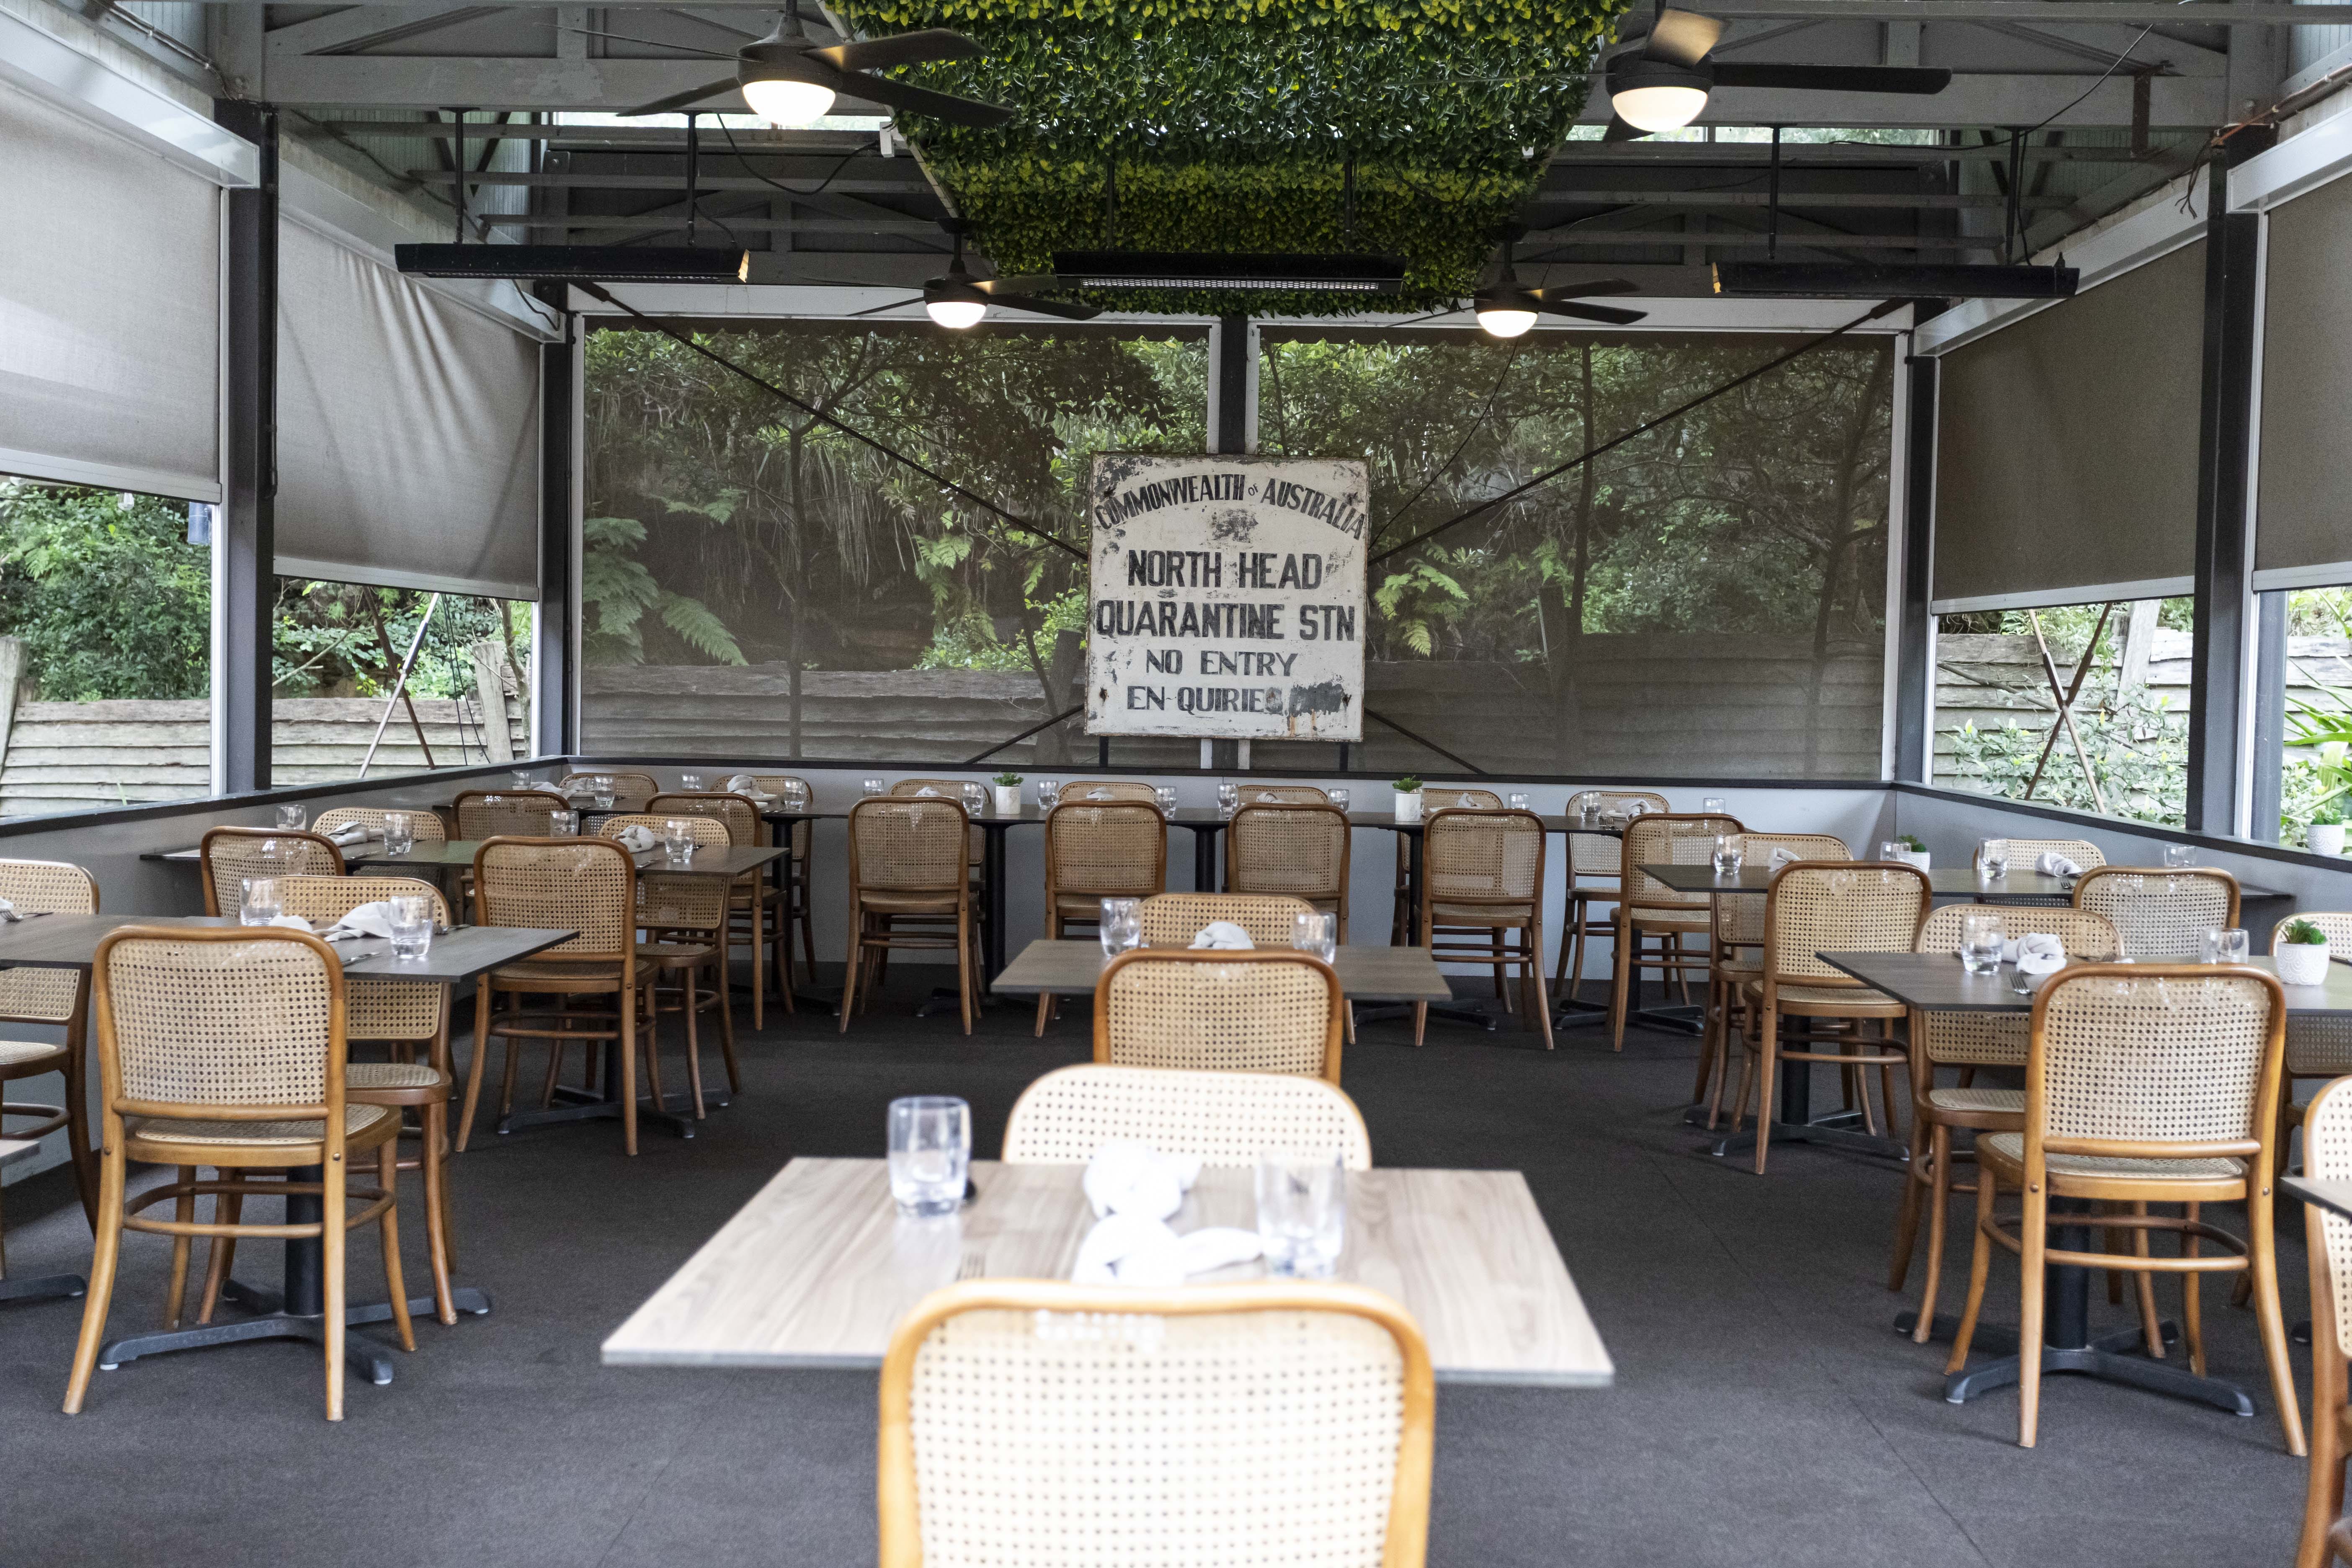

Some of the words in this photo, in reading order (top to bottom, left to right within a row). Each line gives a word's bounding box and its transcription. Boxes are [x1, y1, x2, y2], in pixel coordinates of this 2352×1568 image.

[1095, 474, 1246, 529] COMMONWEALTH
[1260, 478, 1365, 540] AUSTRALIA
[1128, 549, 1222, 588] NORTH
[1238, 552, 1322, 590] HEAD
[1096, 599, 1285, 640] QUARANTINE
[1300, 604, 1355, 641] STN
[1146, 649, 1183, 675] NO
[1200, 650, 1298, 677] ENTRY
